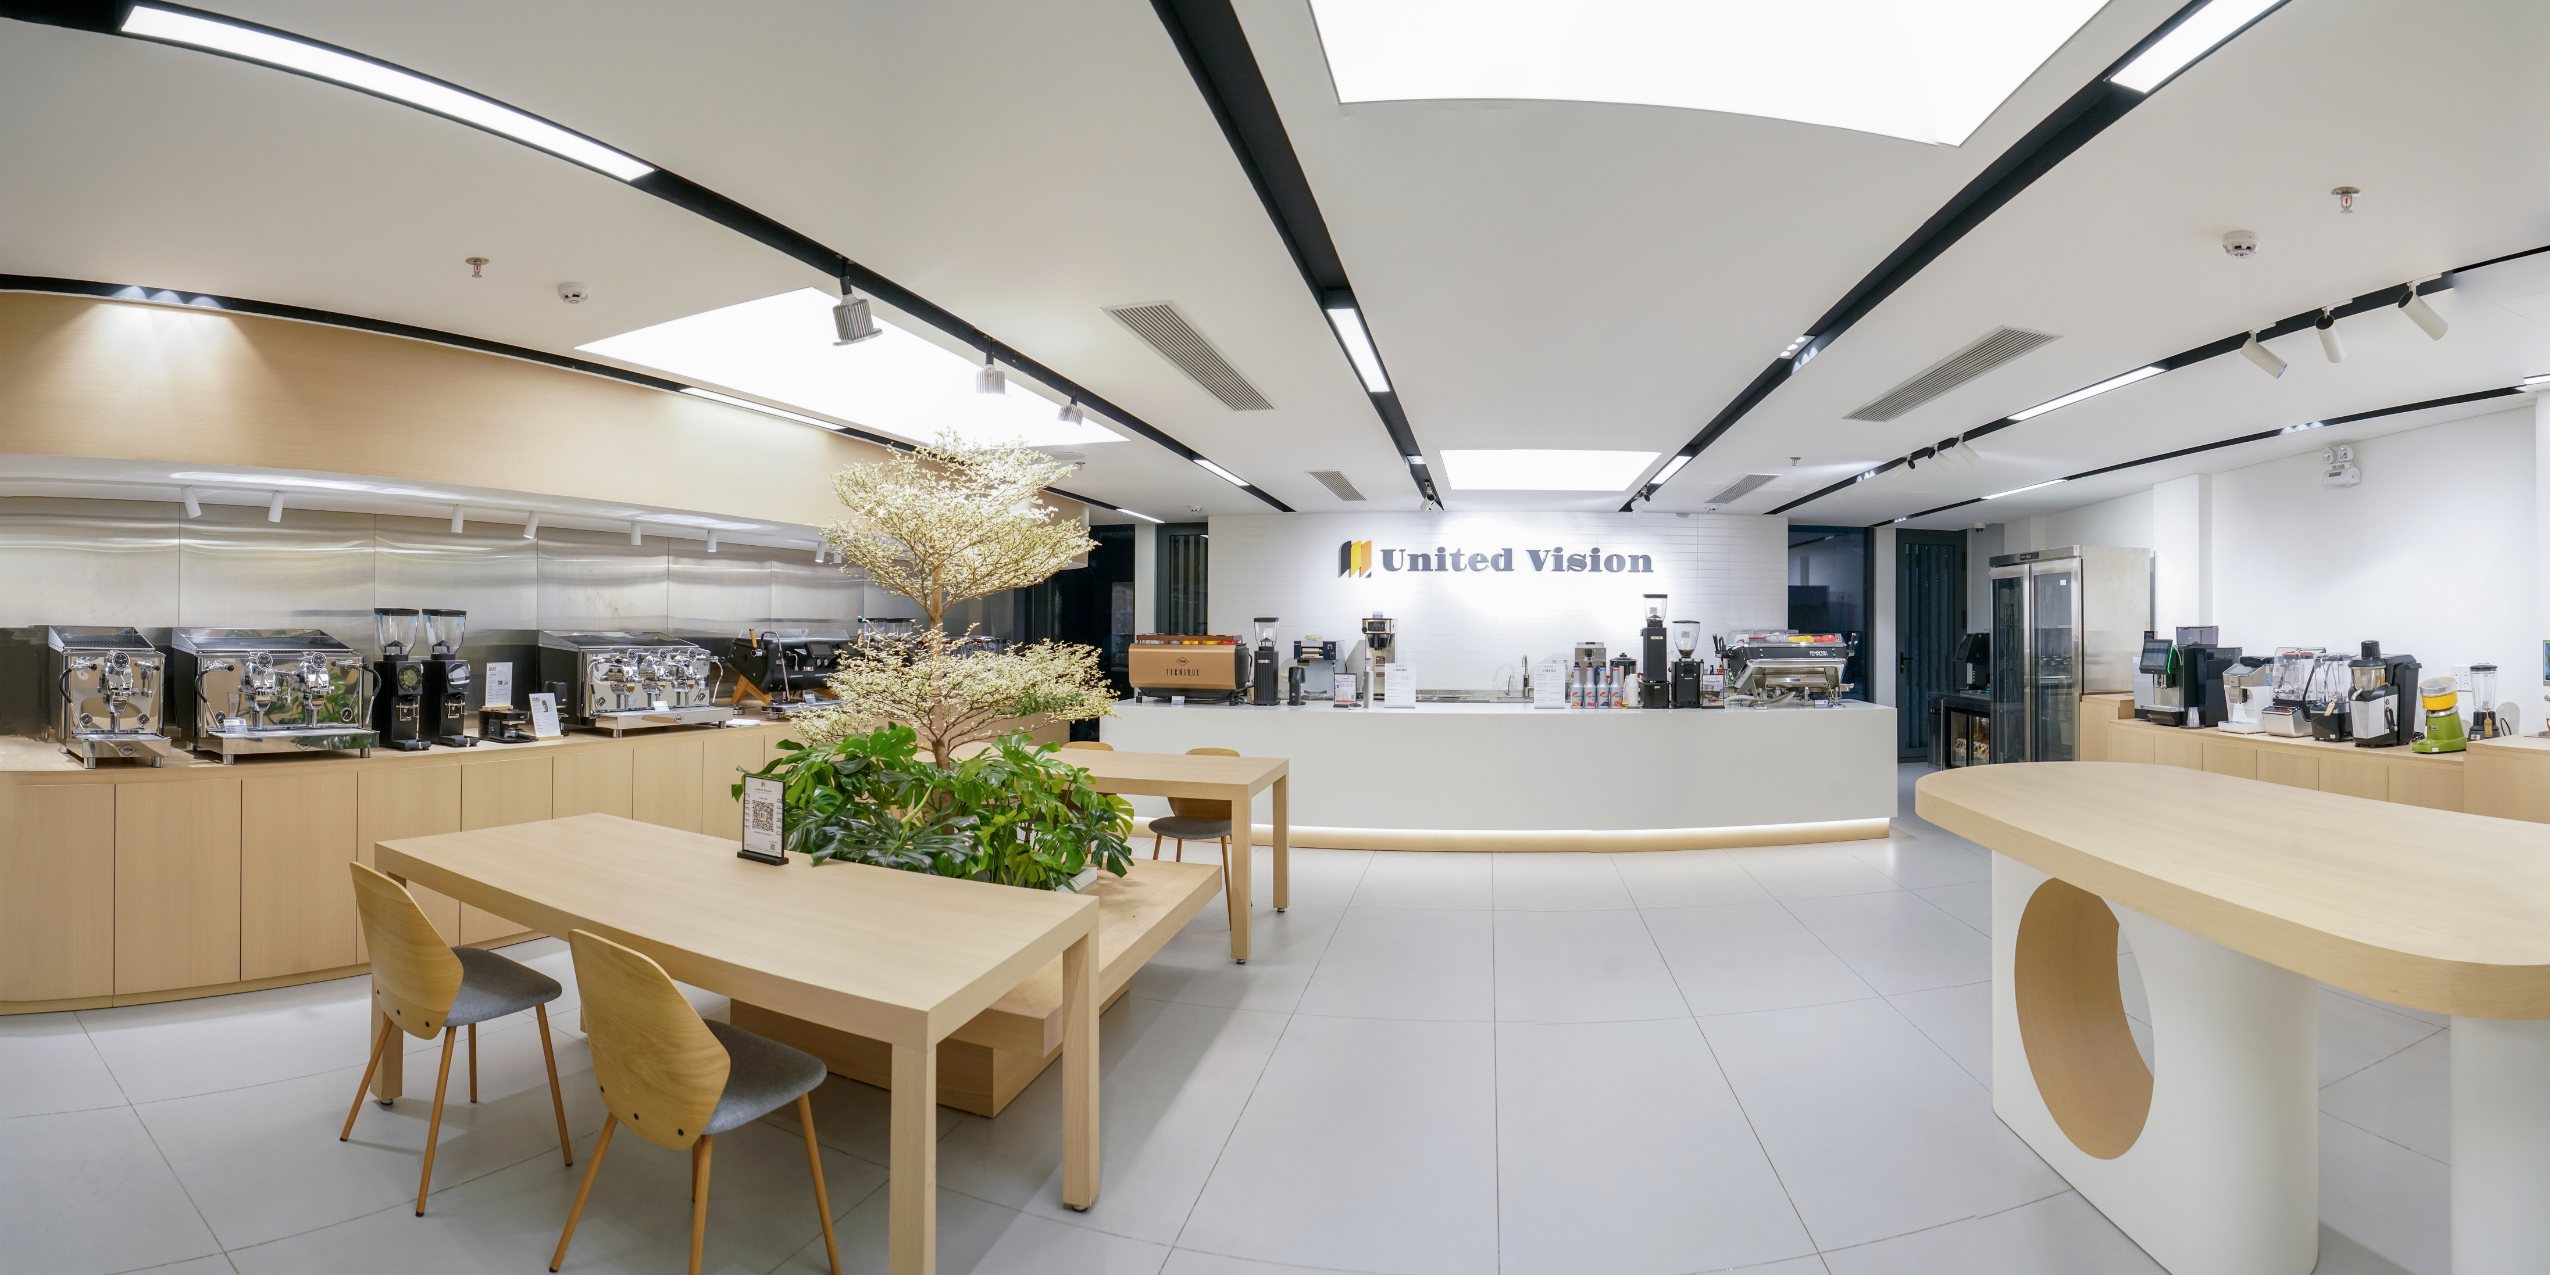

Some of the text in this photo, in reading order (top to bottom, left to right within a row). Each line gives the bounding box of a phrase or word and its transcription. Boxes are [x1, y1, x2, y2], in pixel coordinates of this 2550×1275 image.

[1379, 546, 1654, 573] United Vision
[1166, 668, 1200, 676] TECNIQUE
